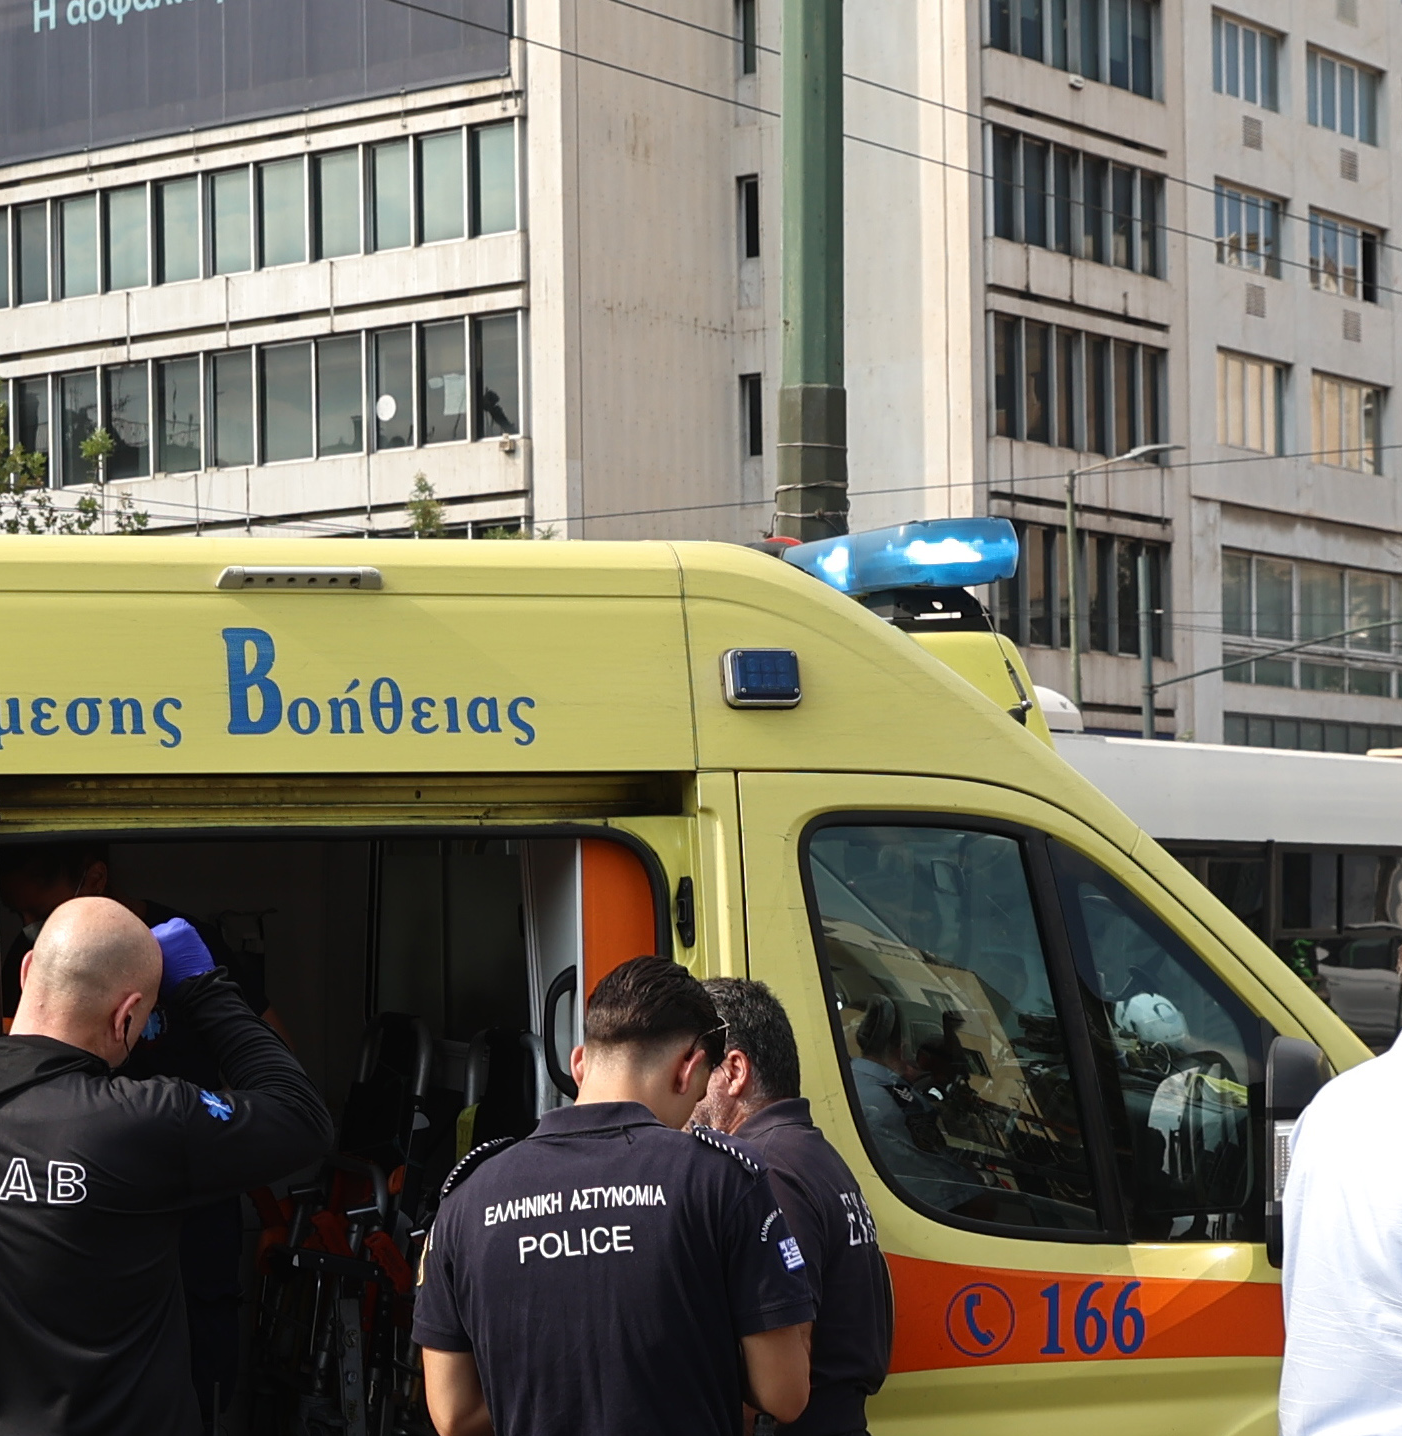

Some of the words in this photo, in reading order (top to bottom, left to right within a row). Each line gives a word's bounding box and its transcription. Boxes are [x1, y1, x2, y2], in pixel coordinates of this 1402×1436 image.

[222, 626, 537, 747] Βοήθειας
[484, 1192, 563, 1227] ΕΛΛΗΝΙΚΗ
[570, 1184, 666, 1212] ΑΣΤΥΝΟΜΙΑ
[518, 1225, 634, 1264] POLICE
[1039, 1280, 1146, 1356] 166
